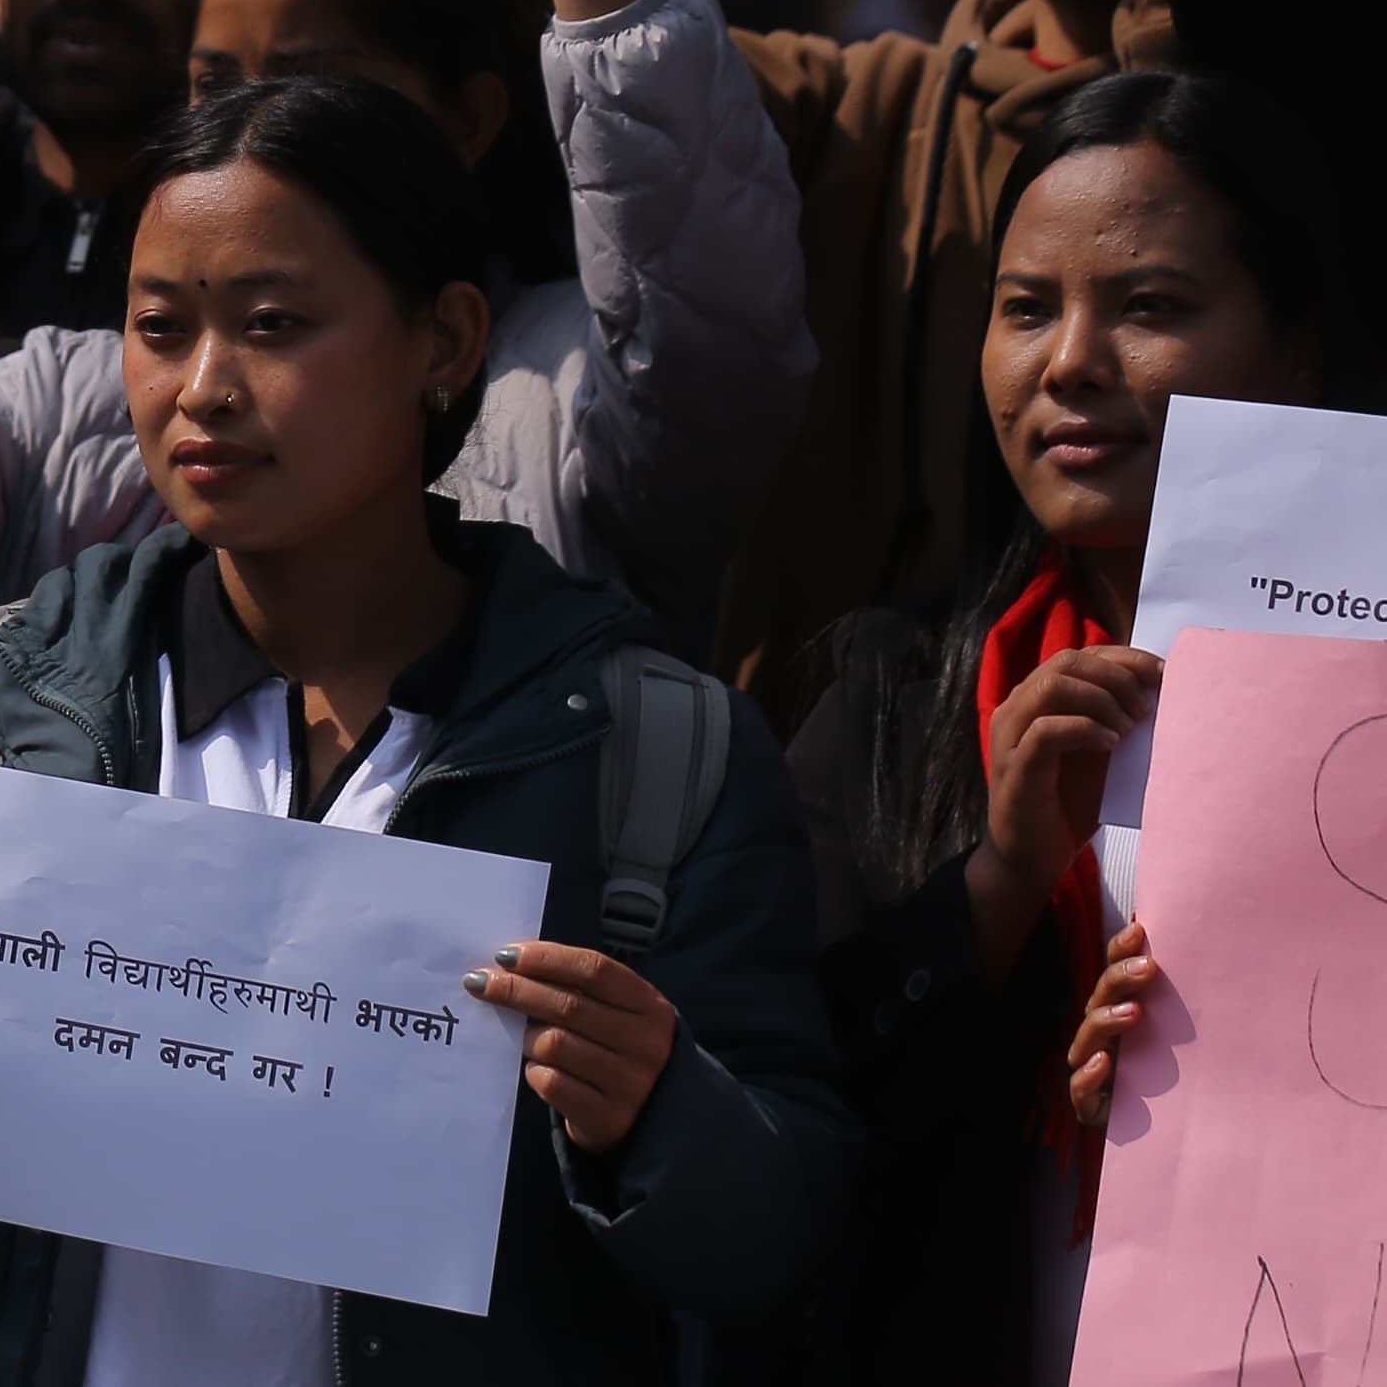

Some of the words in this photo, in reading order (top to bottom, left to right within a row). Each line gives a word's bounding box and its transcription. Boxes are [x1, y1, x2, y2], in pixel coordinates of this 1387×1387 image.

[355, 999, 460, 1046] भएको
[54, 1017, 141, 1061] दमन
[159, 1037, 235, 1082] बन्द
[252, 1054, 304, 1093] गर
[323, 1065, 335, 1098] !
